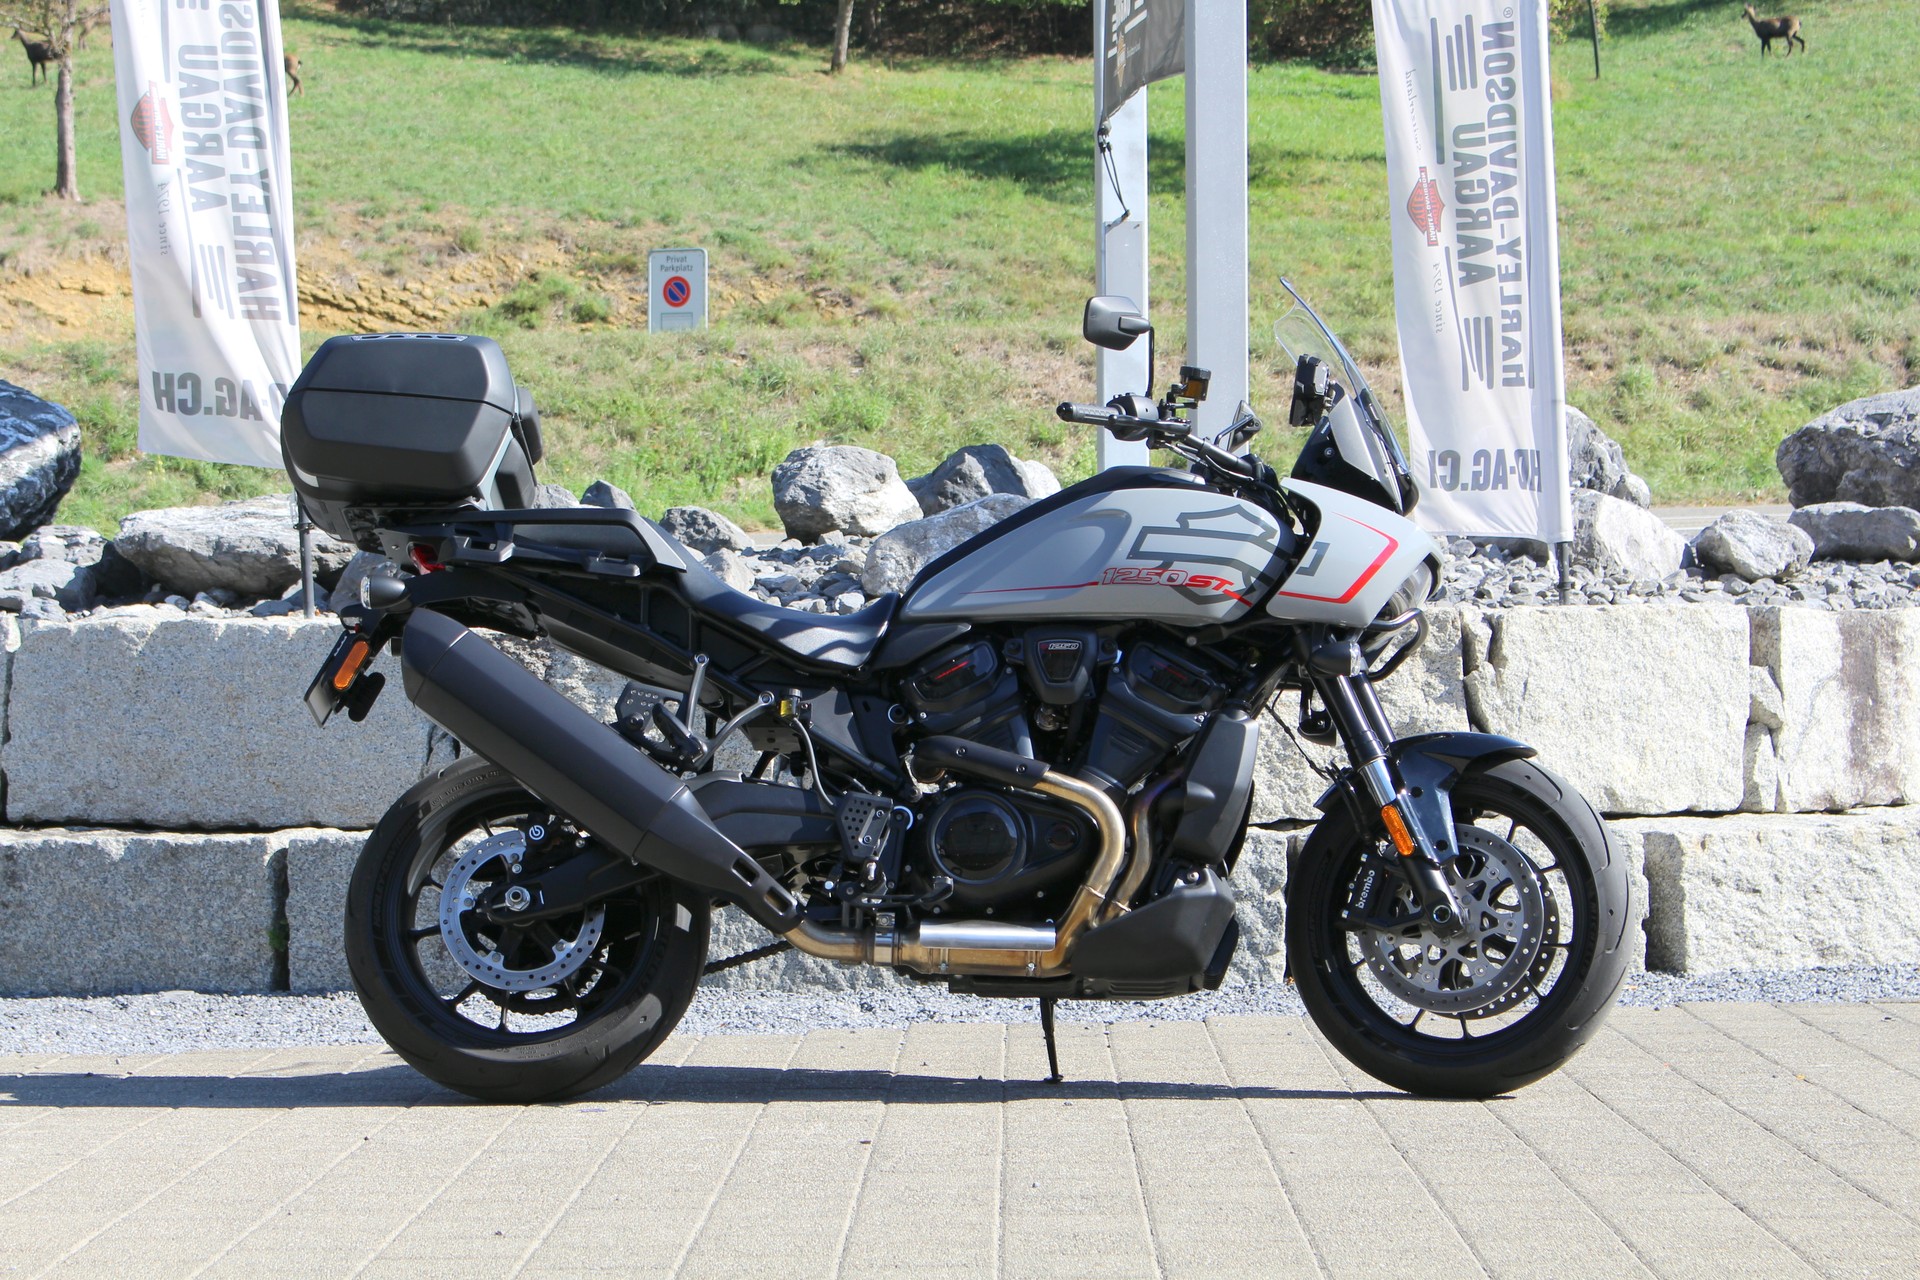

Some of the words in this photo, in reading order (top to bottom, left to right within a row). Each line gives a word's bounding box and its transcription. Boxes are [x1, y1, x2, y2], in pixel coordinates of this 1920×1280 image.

[666, 255, 687, 263] Privat
[660, 264, 693, 273] Parkplatz
[1355, 870, 1375, 909] brembo
